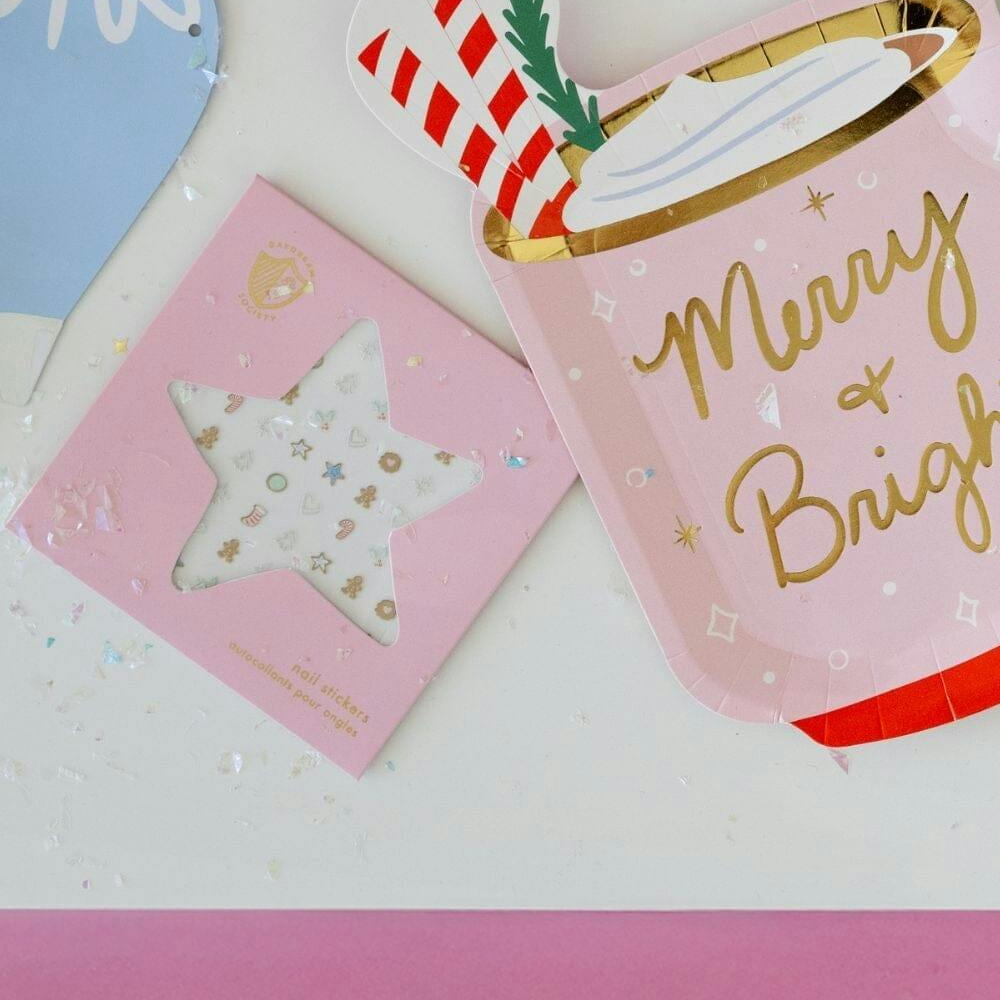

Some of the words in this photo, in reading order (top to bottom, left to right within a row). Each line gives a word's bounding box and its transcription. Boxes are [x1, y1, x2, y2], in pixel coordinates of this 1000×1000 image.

[633, 190, 978, 420] Merry
[837, 356, 895, 415] &
[291, 664, 321, 685] nail
[321, 685, 368, 723] stickers
[293, 689, 321, 709] pour
